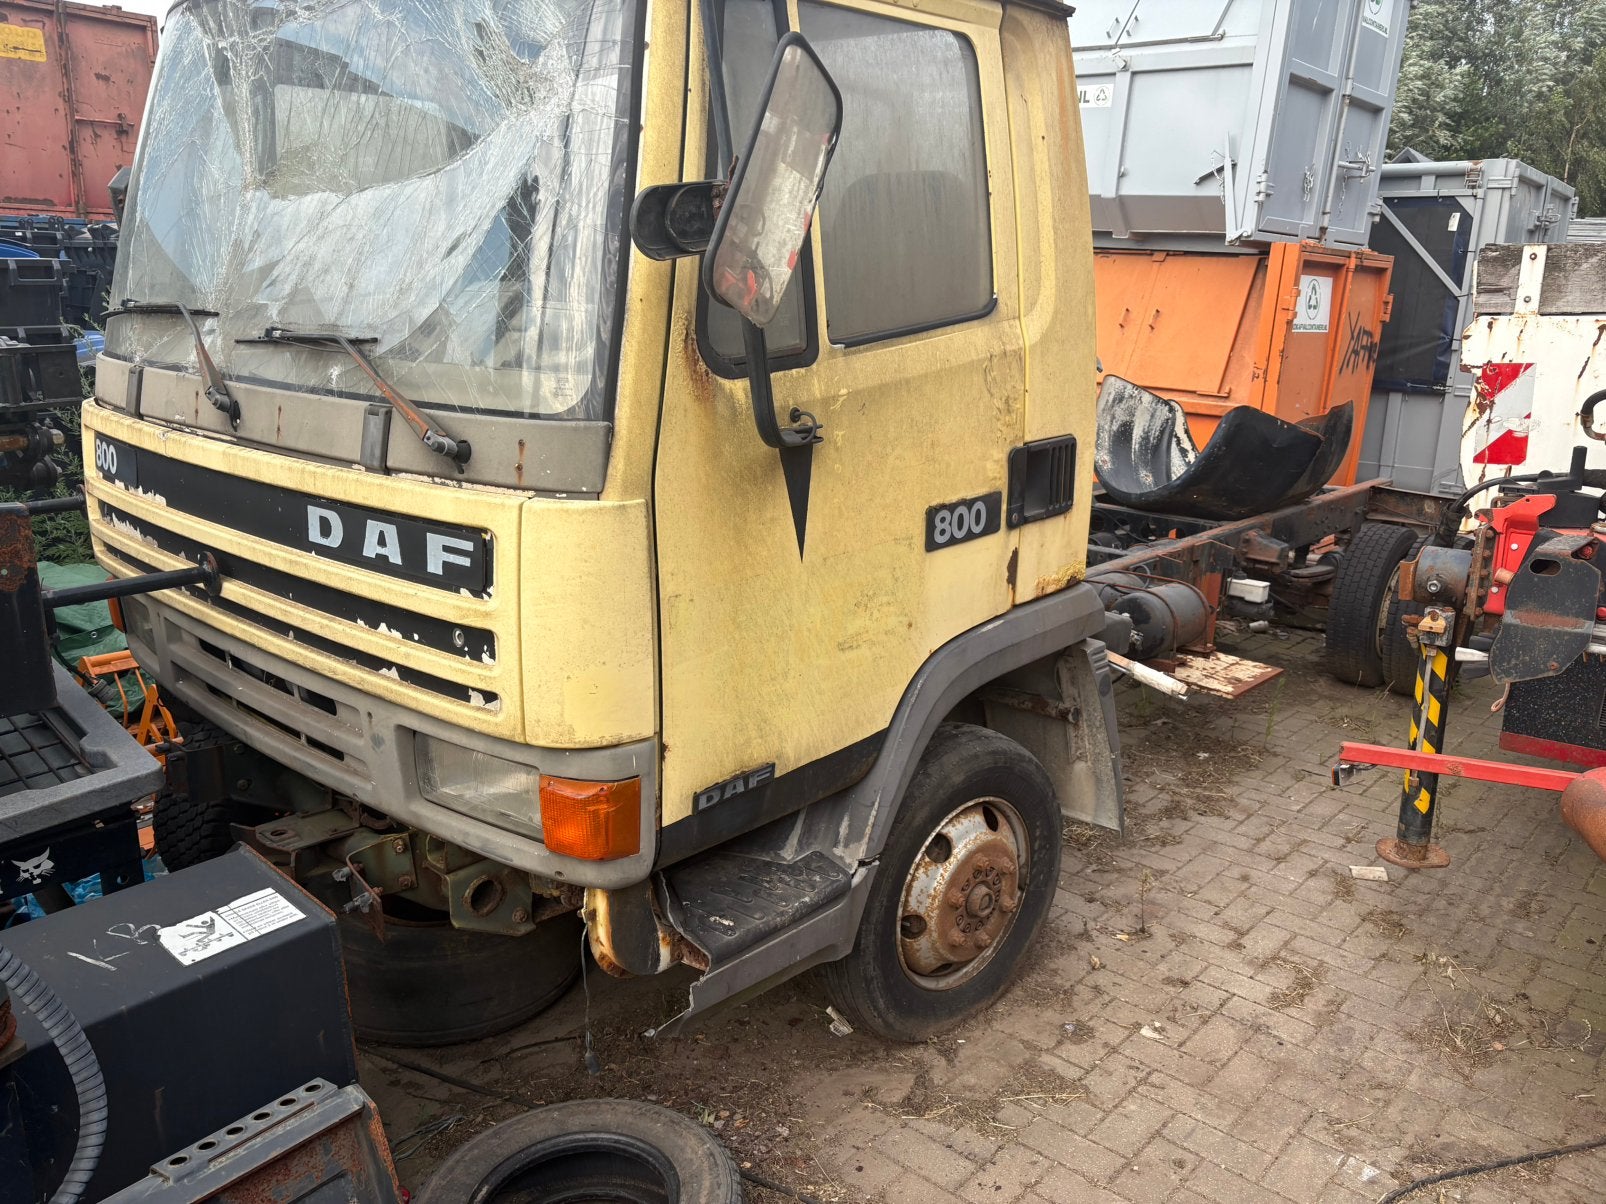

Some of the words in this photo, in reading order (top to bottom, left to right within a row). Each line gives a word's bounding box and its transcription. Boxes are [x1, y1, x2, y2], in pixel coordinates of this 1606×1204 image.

[96, 438, 118, 475] 800
[307, 505, 474, 576] DAF
[934, 501, 987, 544] 800
[698, 765, 774, 810] DAF
